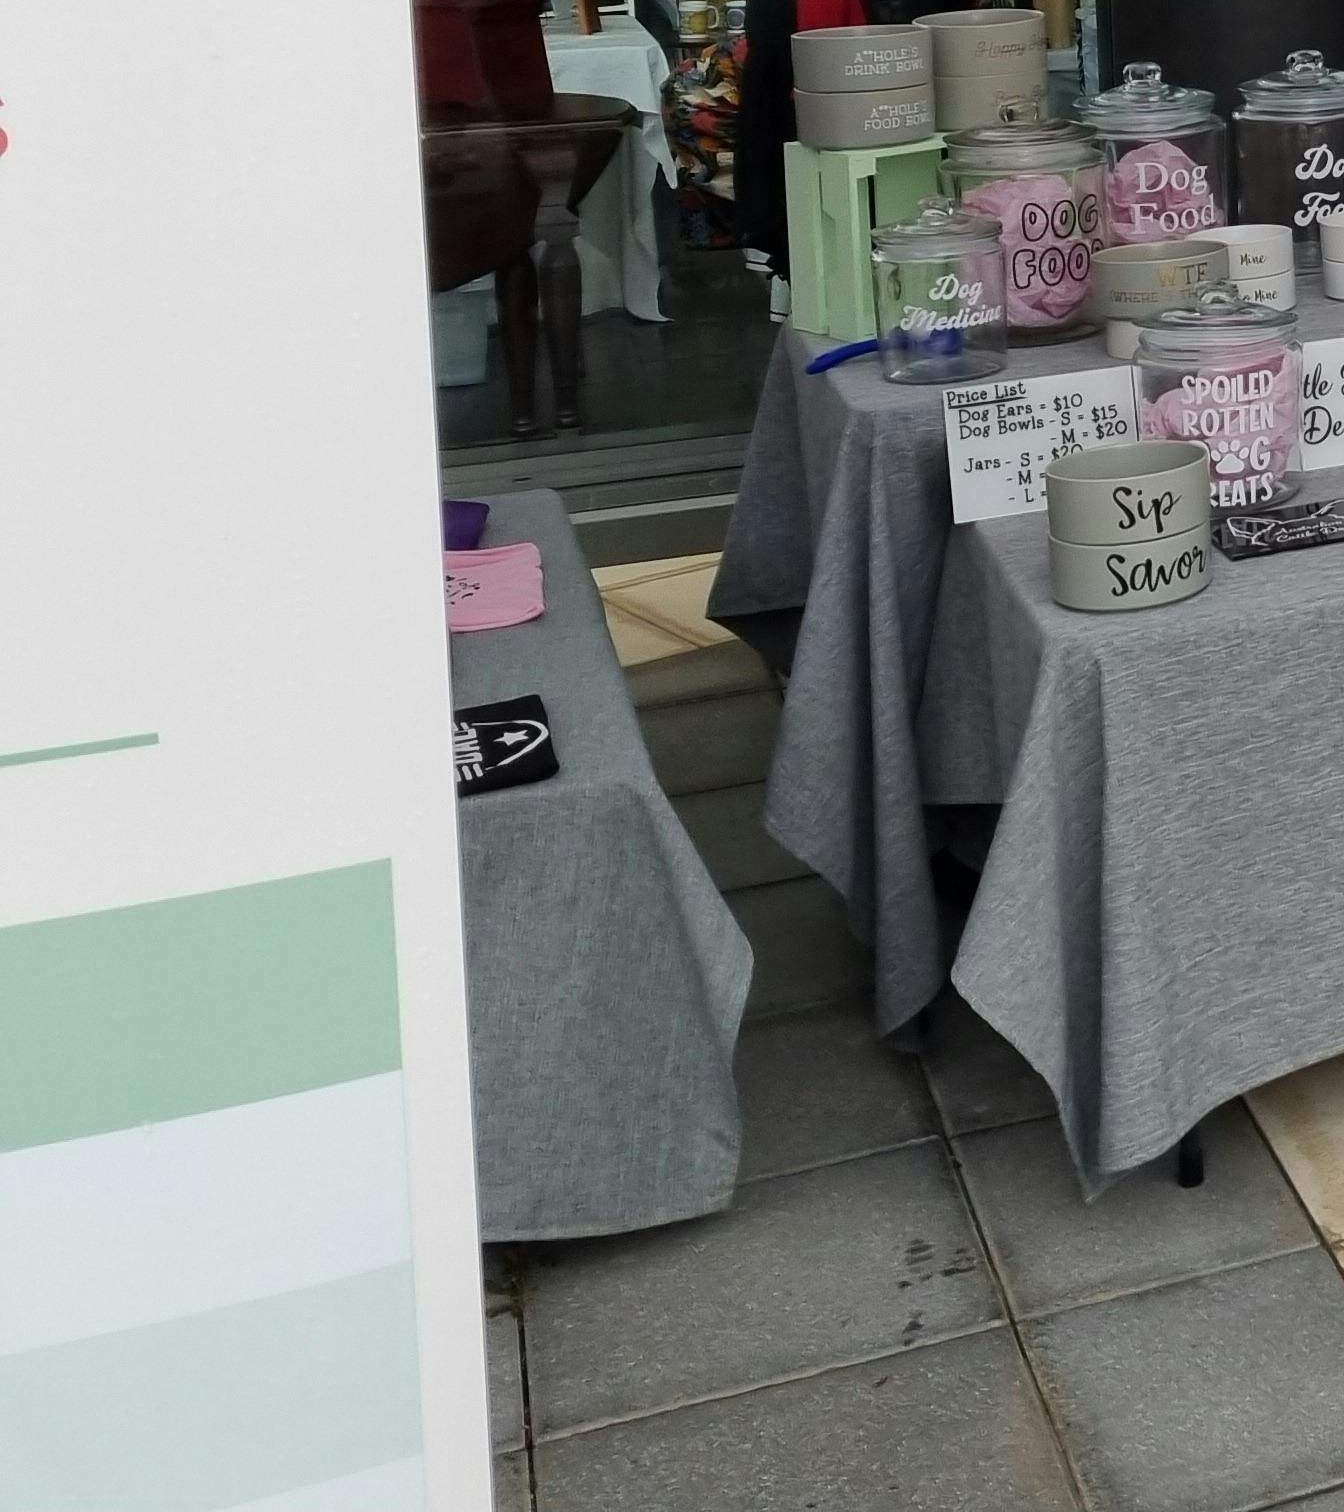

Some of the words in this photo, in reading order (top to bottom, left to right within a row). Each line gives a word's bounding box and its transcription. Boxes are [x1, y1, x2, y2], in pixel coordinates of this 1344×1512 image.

[864, 117, 901, 131] FOOD
[1135, 161, 1209, 196] Dog
[1021, 192, 1099, 242] DOG
[1129, 193, 1216, 236] Food
[928, 272, 984, 302] Dog
[900, 303, 1002, 332] Medicine
[946, 390, 988, 406] Price
[994, 381, 1027, 400] List
[1181, 369, 1274, 405] SPOILED
[958, 408, 990, 424] Dog
[996, 403, 1033, 419] Ears
[1053, 392, 1083, 412] $10
[959, 424, 991, 440] Dog
[998, 416, 1045, 435] Bowls
[1060, 411, 1071, 426] S
[1091, 404, 1118, 423] $15
[1181, 402, 1274, 438] ROTTEN
[1061, 429, 1076, 444] M
[1096, 420, 1128, 439] $20
[963, 458, 1001, 473] Jars
[1020, 452, 1031, 467] S
[1018, 470, 1032, 486] M
[1025, 488, 1035, 504] L
[1112, 485, 1183, 534] Sip
[1106, 544, 1207, 598] Savor
